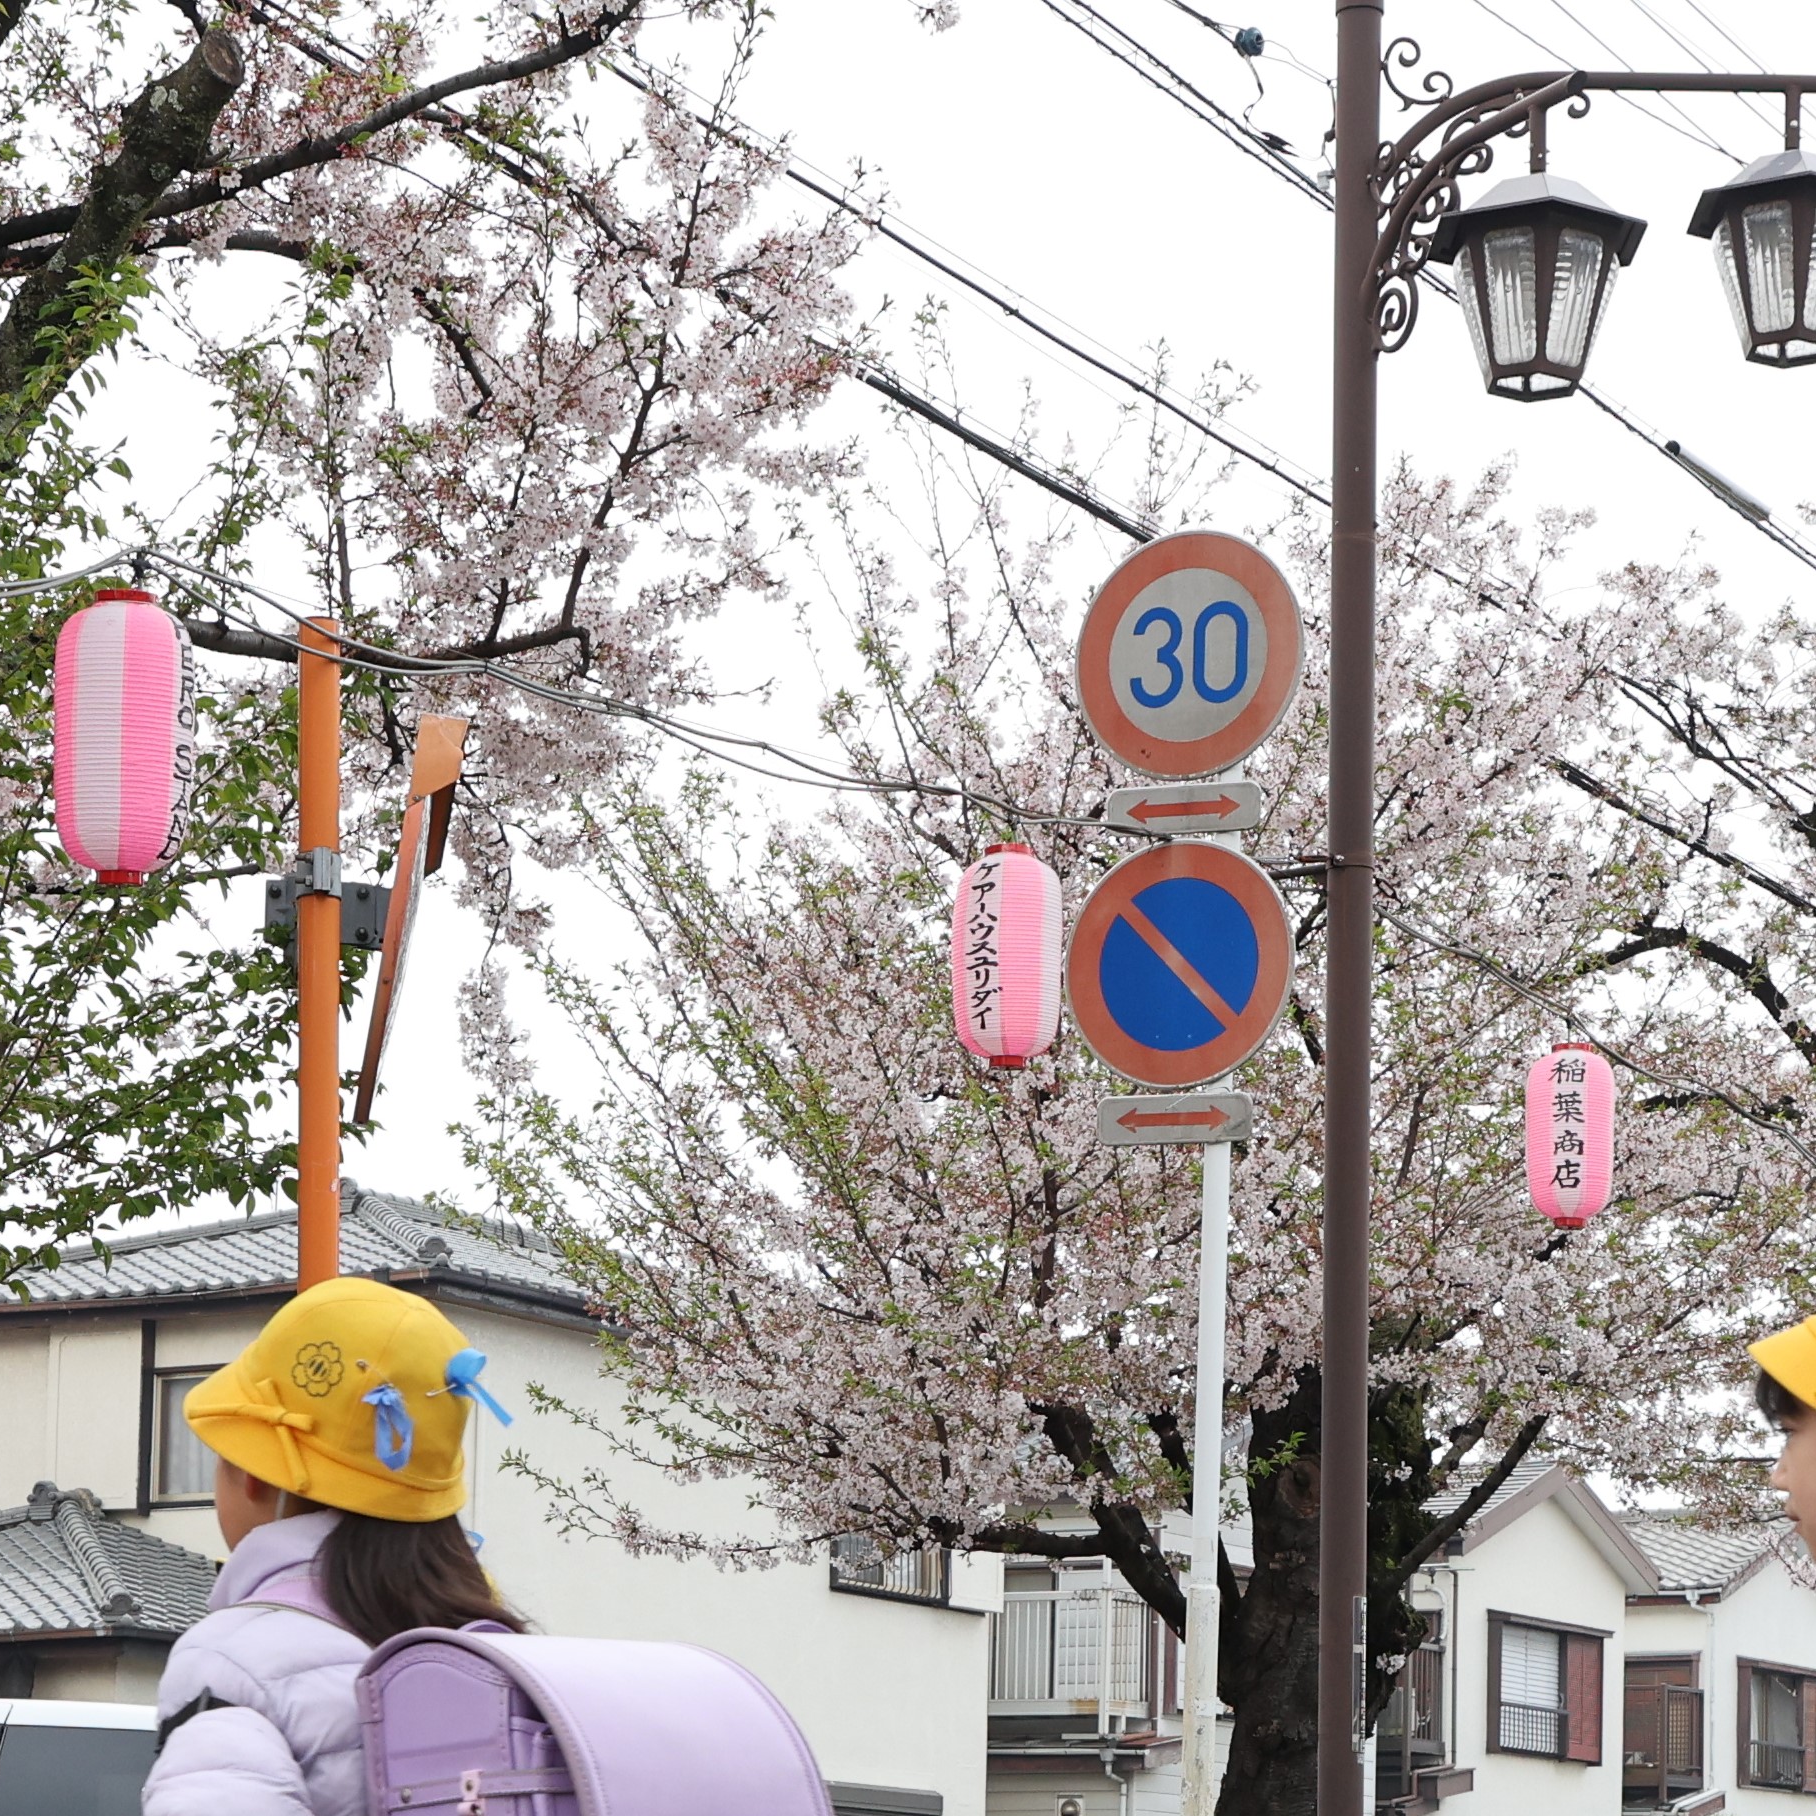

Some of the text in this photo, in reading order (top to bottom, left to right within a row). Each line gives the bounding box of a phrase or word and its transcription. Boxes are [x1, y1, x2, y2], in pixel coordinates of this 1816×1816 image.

[1129, 600, 1249, 708] 30
[156, 744, 192, 860] STAND
[965, 862, 1003, 1030] ケアーハウスユリダイ
[1548, 1058, 1586, 1189] 稲葉商店
